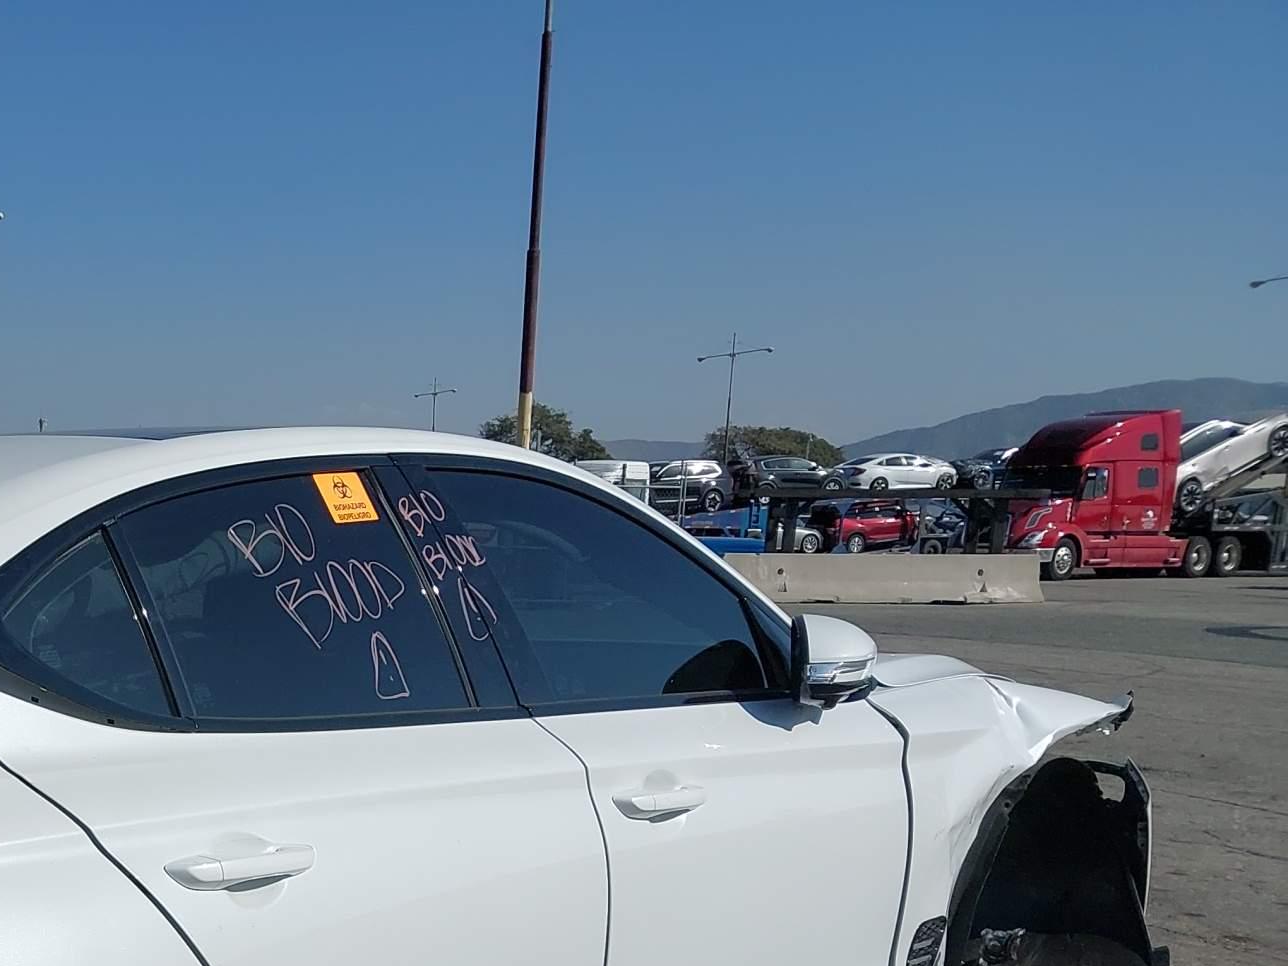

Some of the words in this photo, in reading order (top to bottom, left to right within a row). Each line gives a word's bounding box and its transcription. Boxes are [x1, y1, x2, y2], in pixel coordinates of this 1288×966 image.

[333, 502, 367, 512] BIOHAZARD
[337, 511, 372, 521] BIOPELIGRO
[397, 489, 445, 538] BIO
[227, 503, 316, 578] BIO
